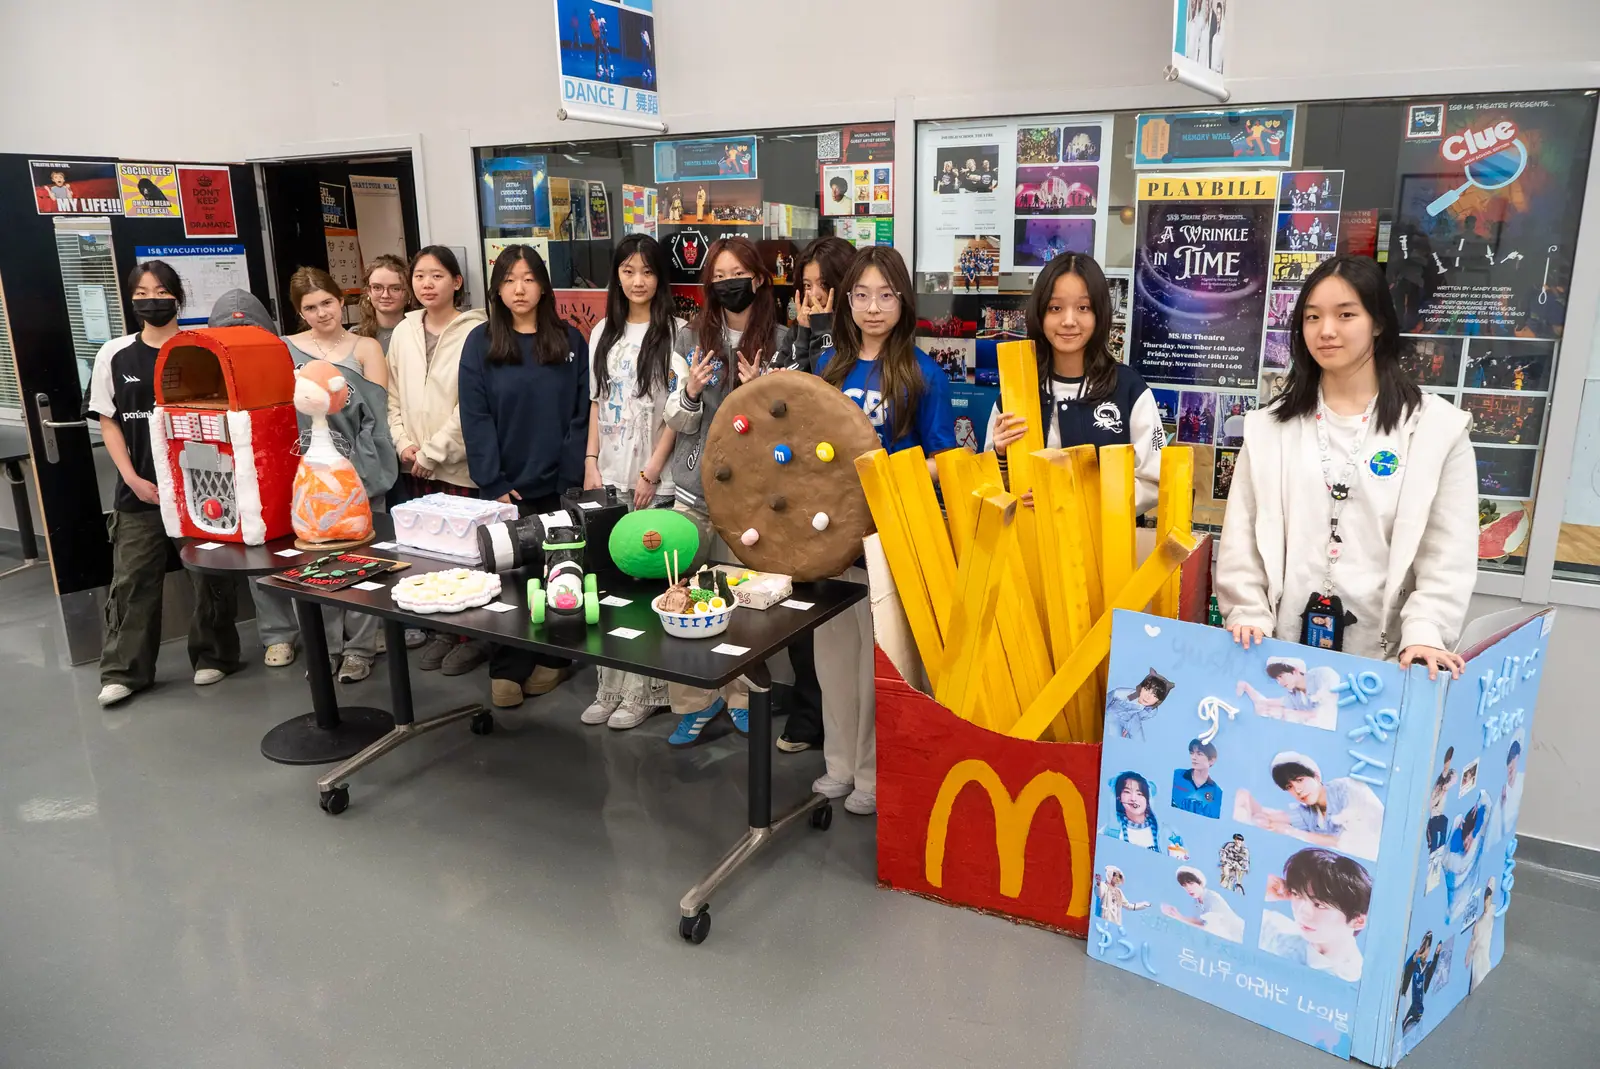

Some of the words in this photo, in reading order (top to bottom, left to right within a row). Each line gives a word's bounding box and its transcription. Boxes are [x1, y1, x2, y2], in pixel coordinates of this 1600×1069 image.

[565, 79, 615, 106] DANCE
[1476, 102, 1508, 110] THEATRE
[1182, 133, 1210, 141] MEMORY
[1212, 132, 1231, 140] WALL
[1442, 121, 1515, 161] Clue
[121, 166, 150, 175] SOCIAL
[151, 167, 172, 176] LIFE?
[192, 188, 220, 197] DON'T
[1148, 180, 1266, 197] PLAYBILL
[57, 198, 78, 212] MY
[80, 198, 122, 212] LIFE!!!
[196, 196, 219, 205] KEEP
[189, 221, 231, 229] DRAMATIC
[1157, 226, 1174, 244] A
[1179, 225, 1249, 243] WRINKLE
[1153, 252, 1168, 266] IN
[1173, 244, 1241, 281] TIME
[1193, 333, 1225, 341] Theatre
[1177, 343, 1213, 351] November
[1175, 360, 1210, 368] November
[774, 450, 785, 462] m
[1177, 947, 1234, 983] 등나무
